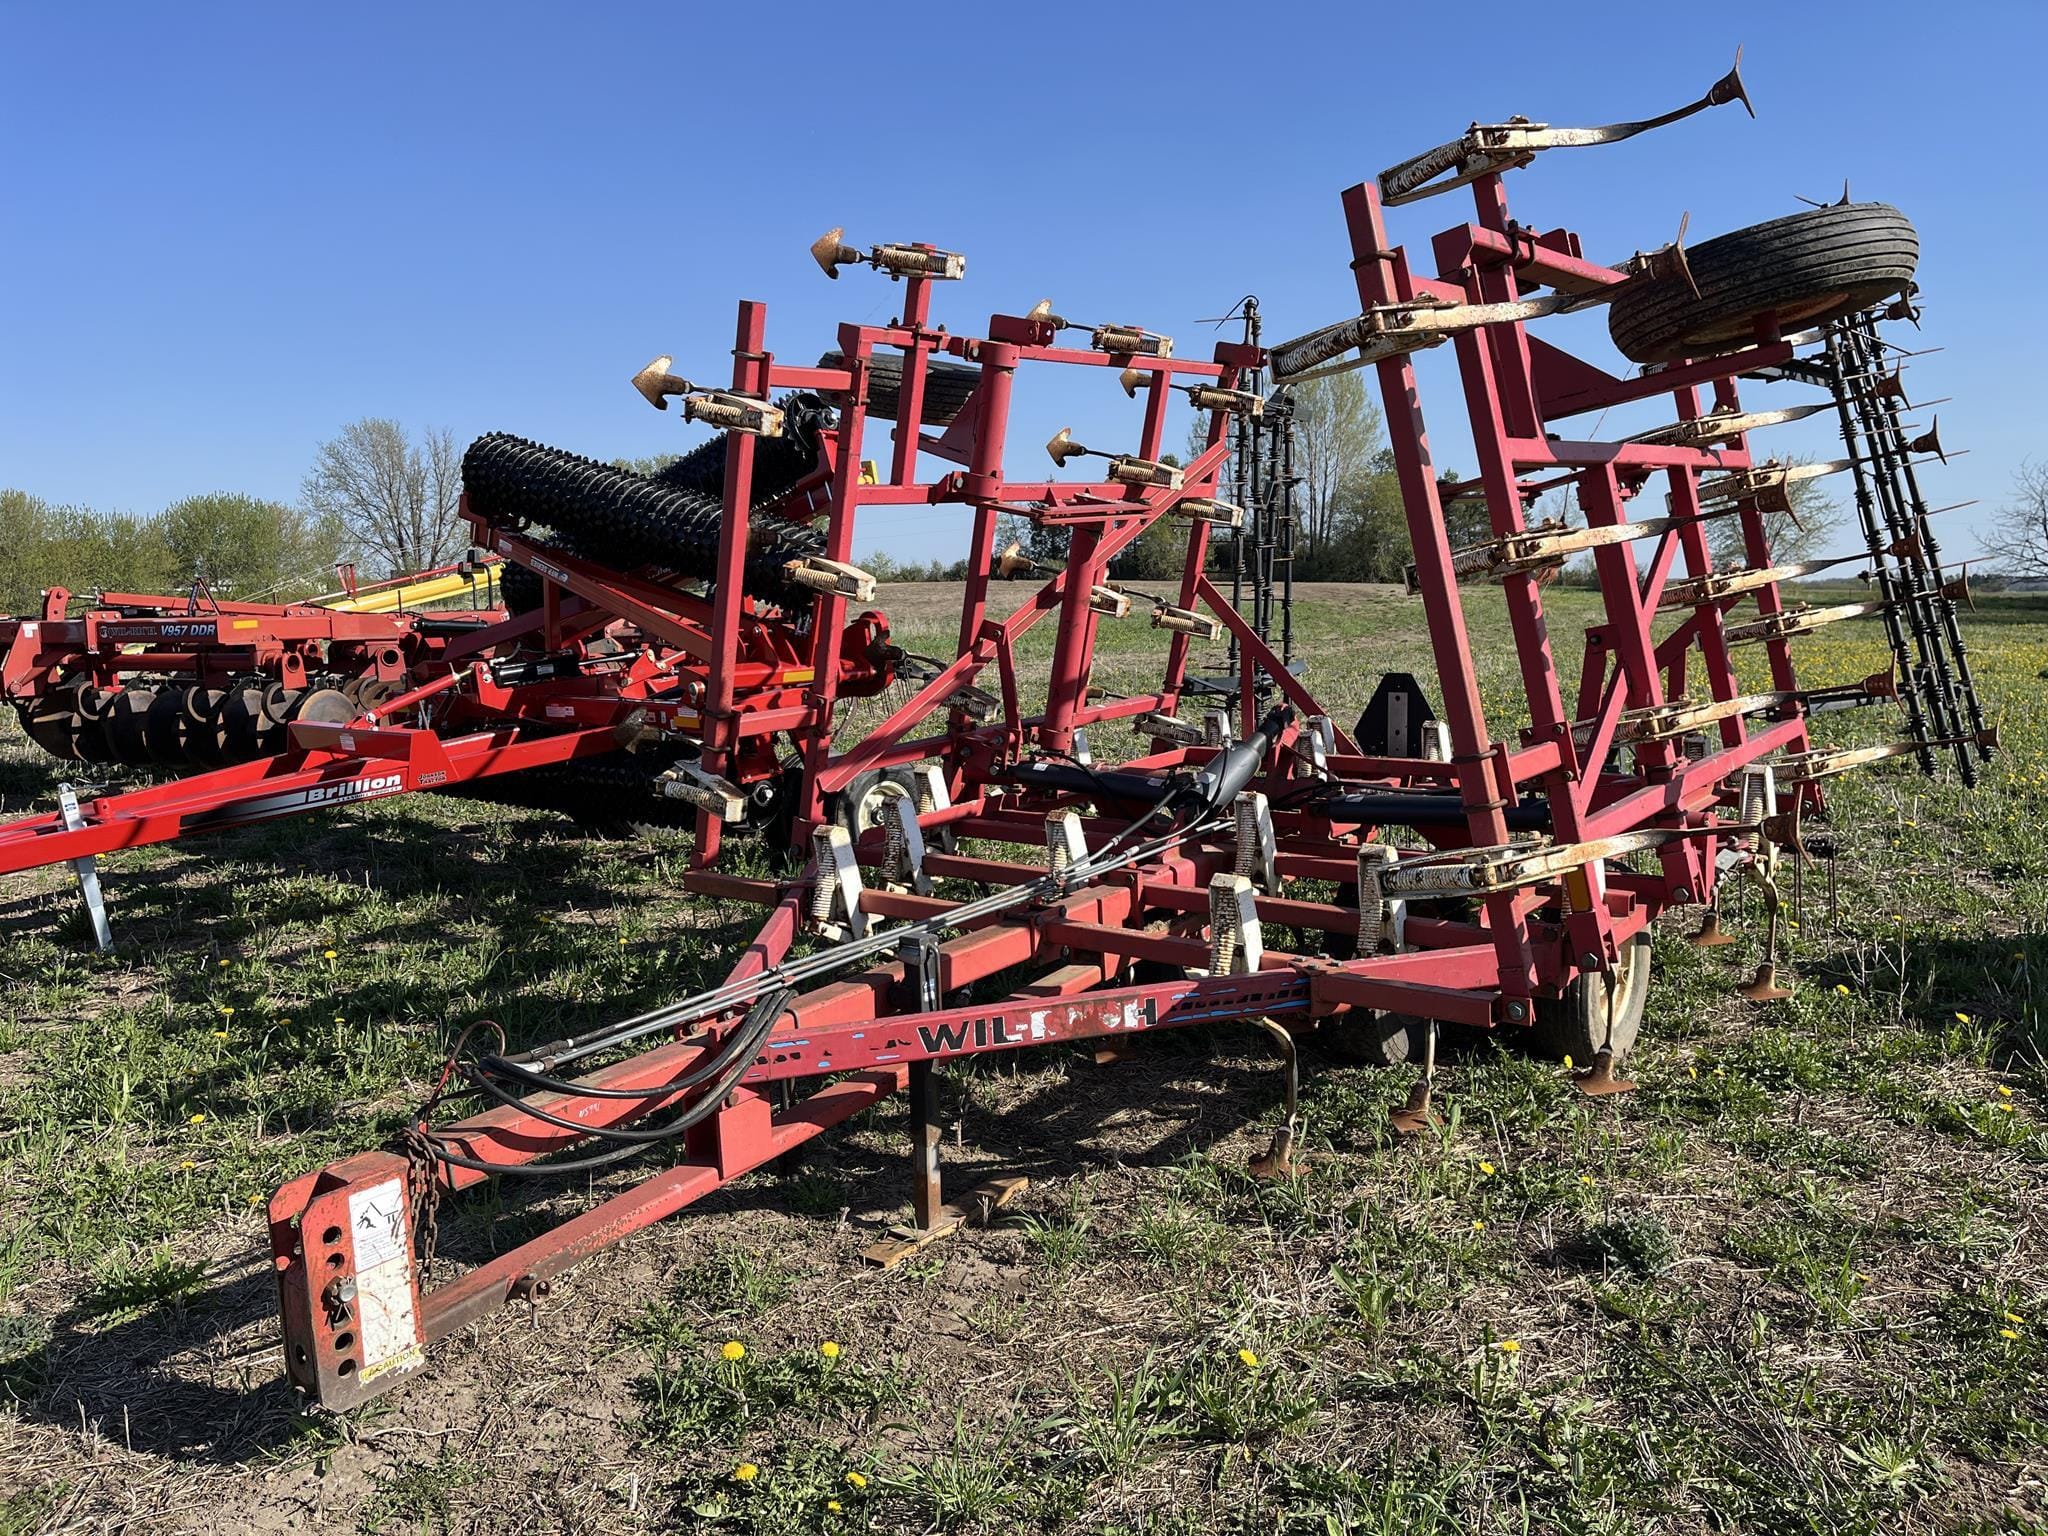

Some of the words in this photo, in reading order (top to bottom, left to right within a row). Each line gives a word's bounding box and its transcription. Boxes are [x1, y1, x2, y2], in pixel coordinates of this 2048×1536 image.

[161, 624, 188, 637] V957
[190, 624, 216, 636] DDR
[307, 774, 401, 803] Brillion
[916, 997, 1159, 1055] WIL-H
[375, 1350, 417, 1372] CAUTION
